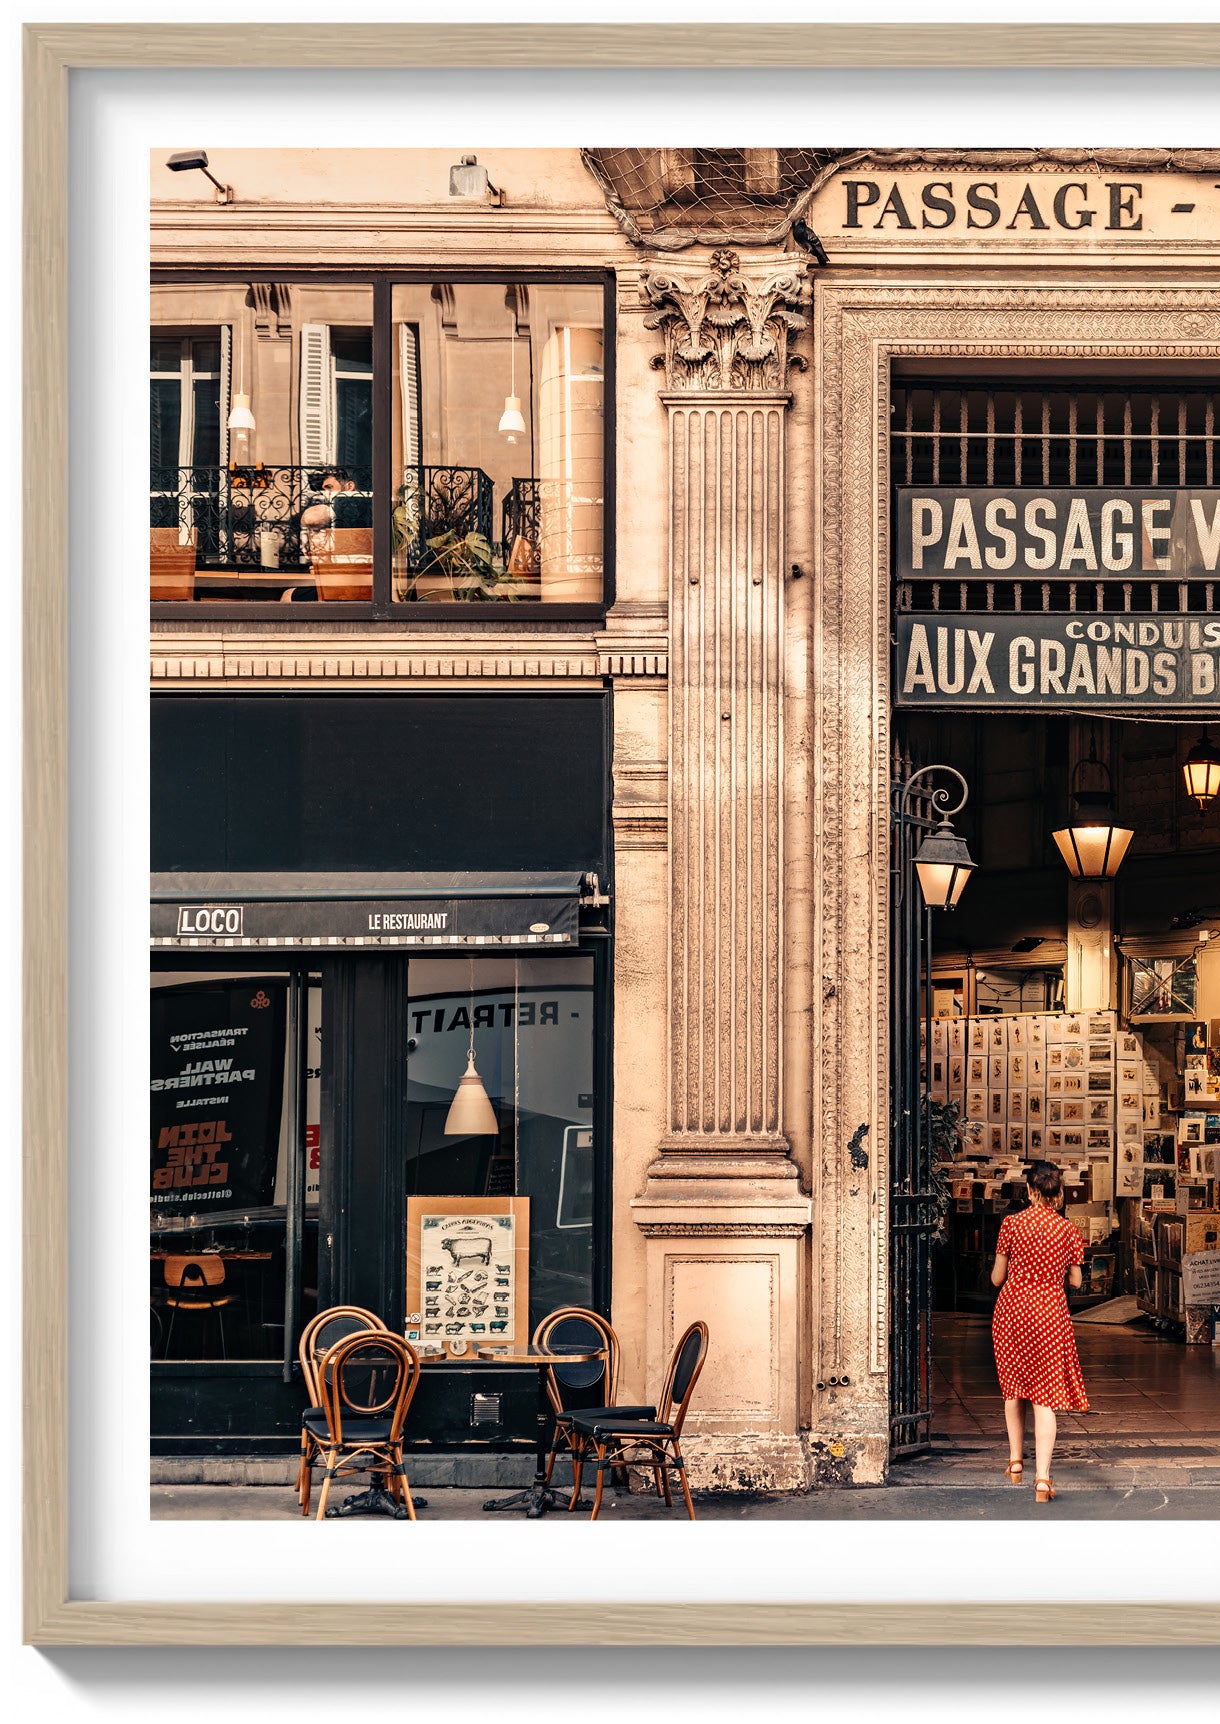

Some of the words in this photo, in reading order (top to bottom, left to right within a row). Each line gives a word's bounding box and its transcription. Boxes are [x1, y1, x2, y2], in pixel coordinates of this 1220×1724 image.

[842, 181, 1144, 231] PASSAGE
[911, 498, 1171, 571] PASSAGE
[903, 623, 996, 695] AUX
[1009, 636, 1178, 696] GRANDS
[181, 909, 239, 933] LOCO
[368, 914, 380, 930] LE
[382, 913, 447, 930] RESTAURANT
